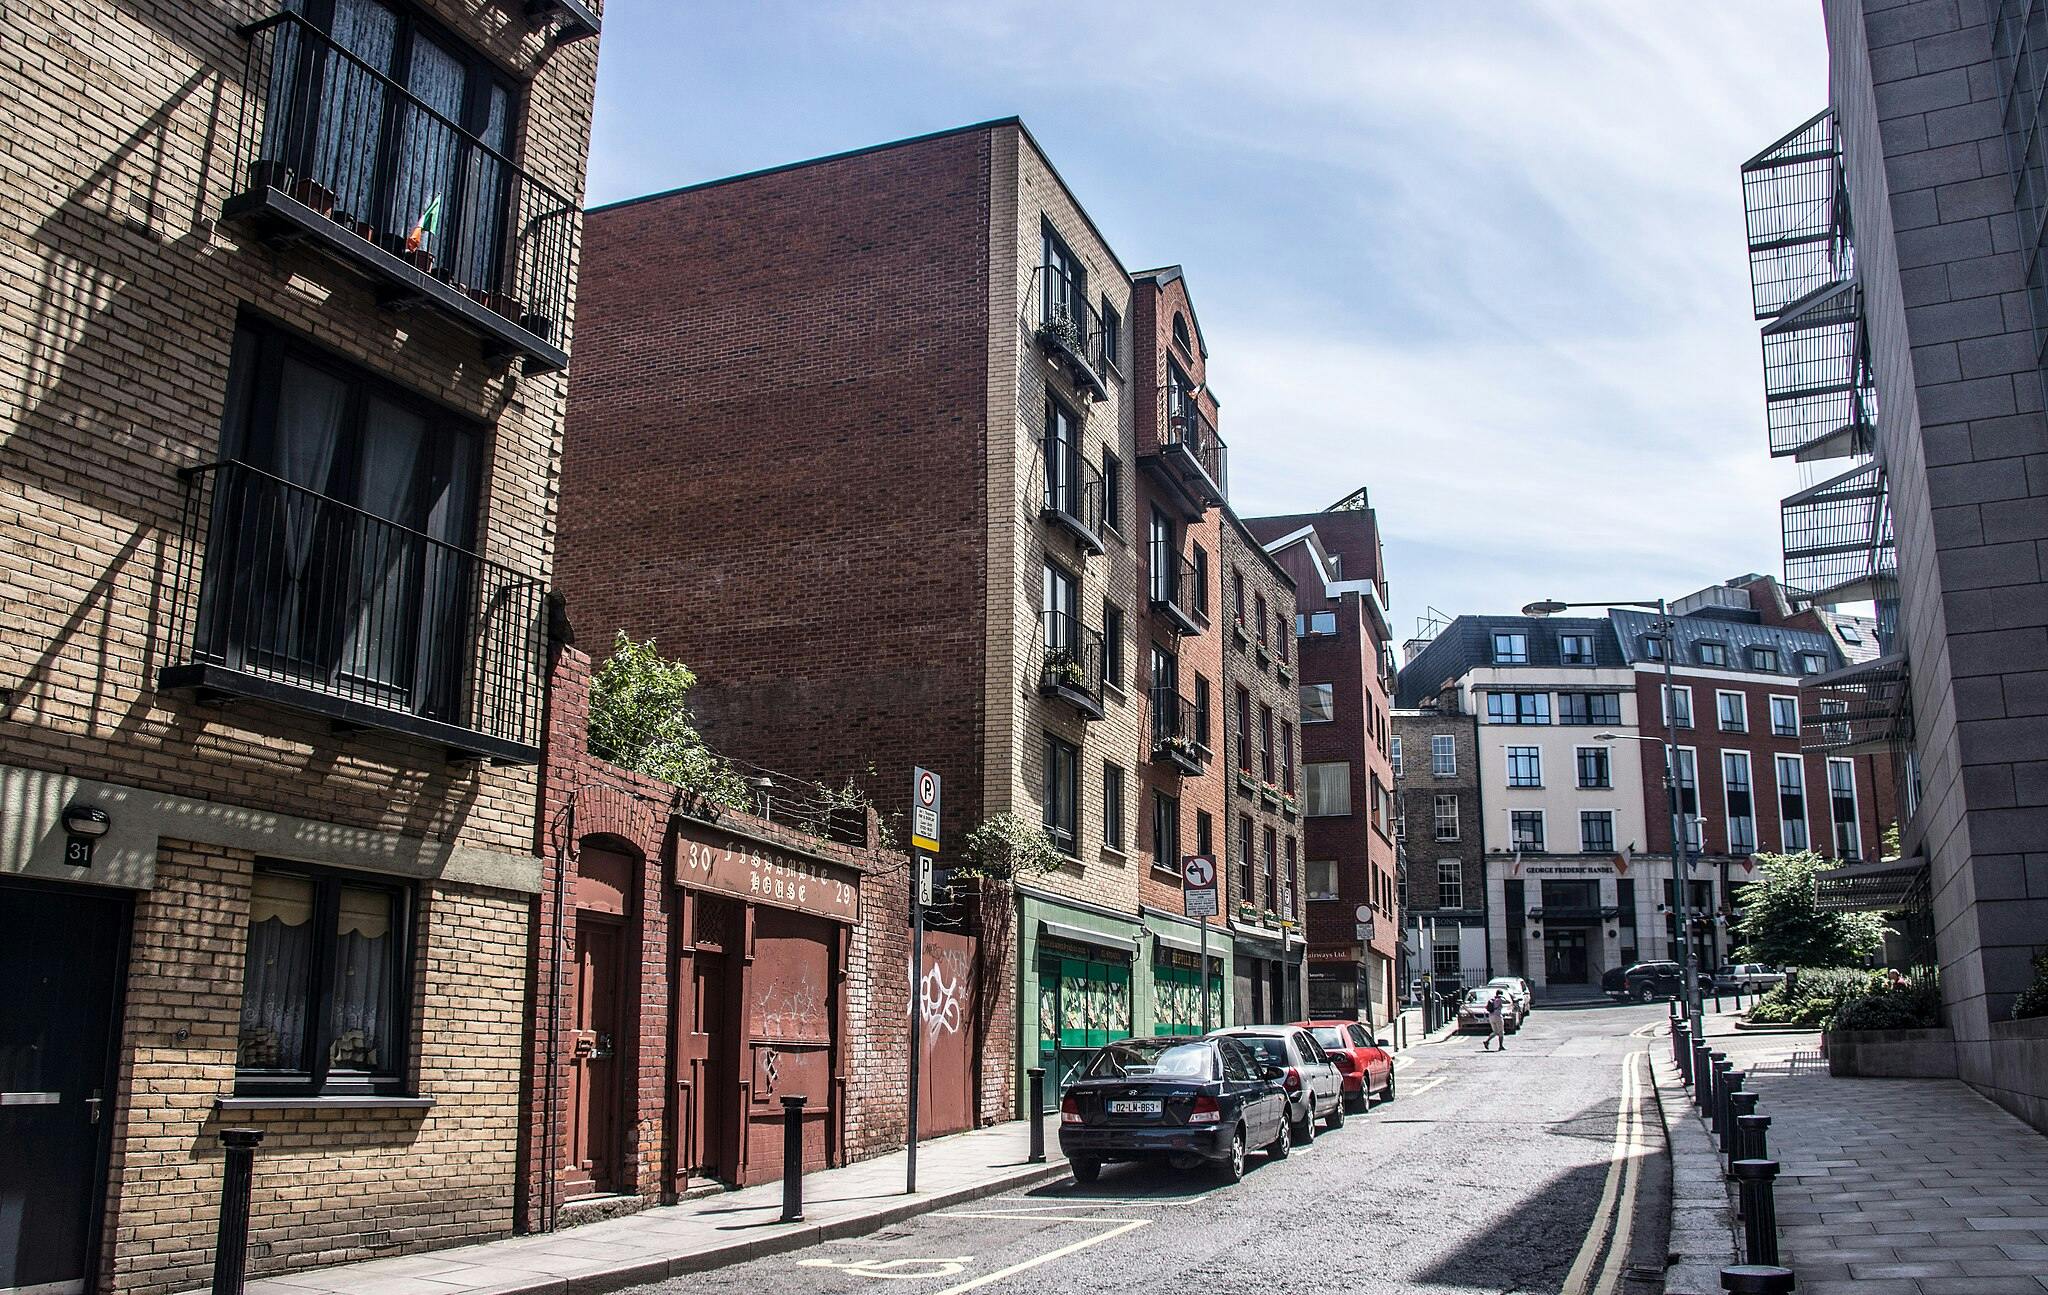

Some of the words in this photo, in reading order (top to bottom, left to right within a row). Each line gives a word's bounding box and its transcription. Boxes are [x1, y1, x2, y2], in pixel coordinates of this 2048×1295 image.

[70, 843, 89, 861] 31
[688, 843, 711, 872] 30
[923, 859, 930, 879] P
[749, 871, 807, 903] HOUSE
[835, 880, 851, 905] 29
